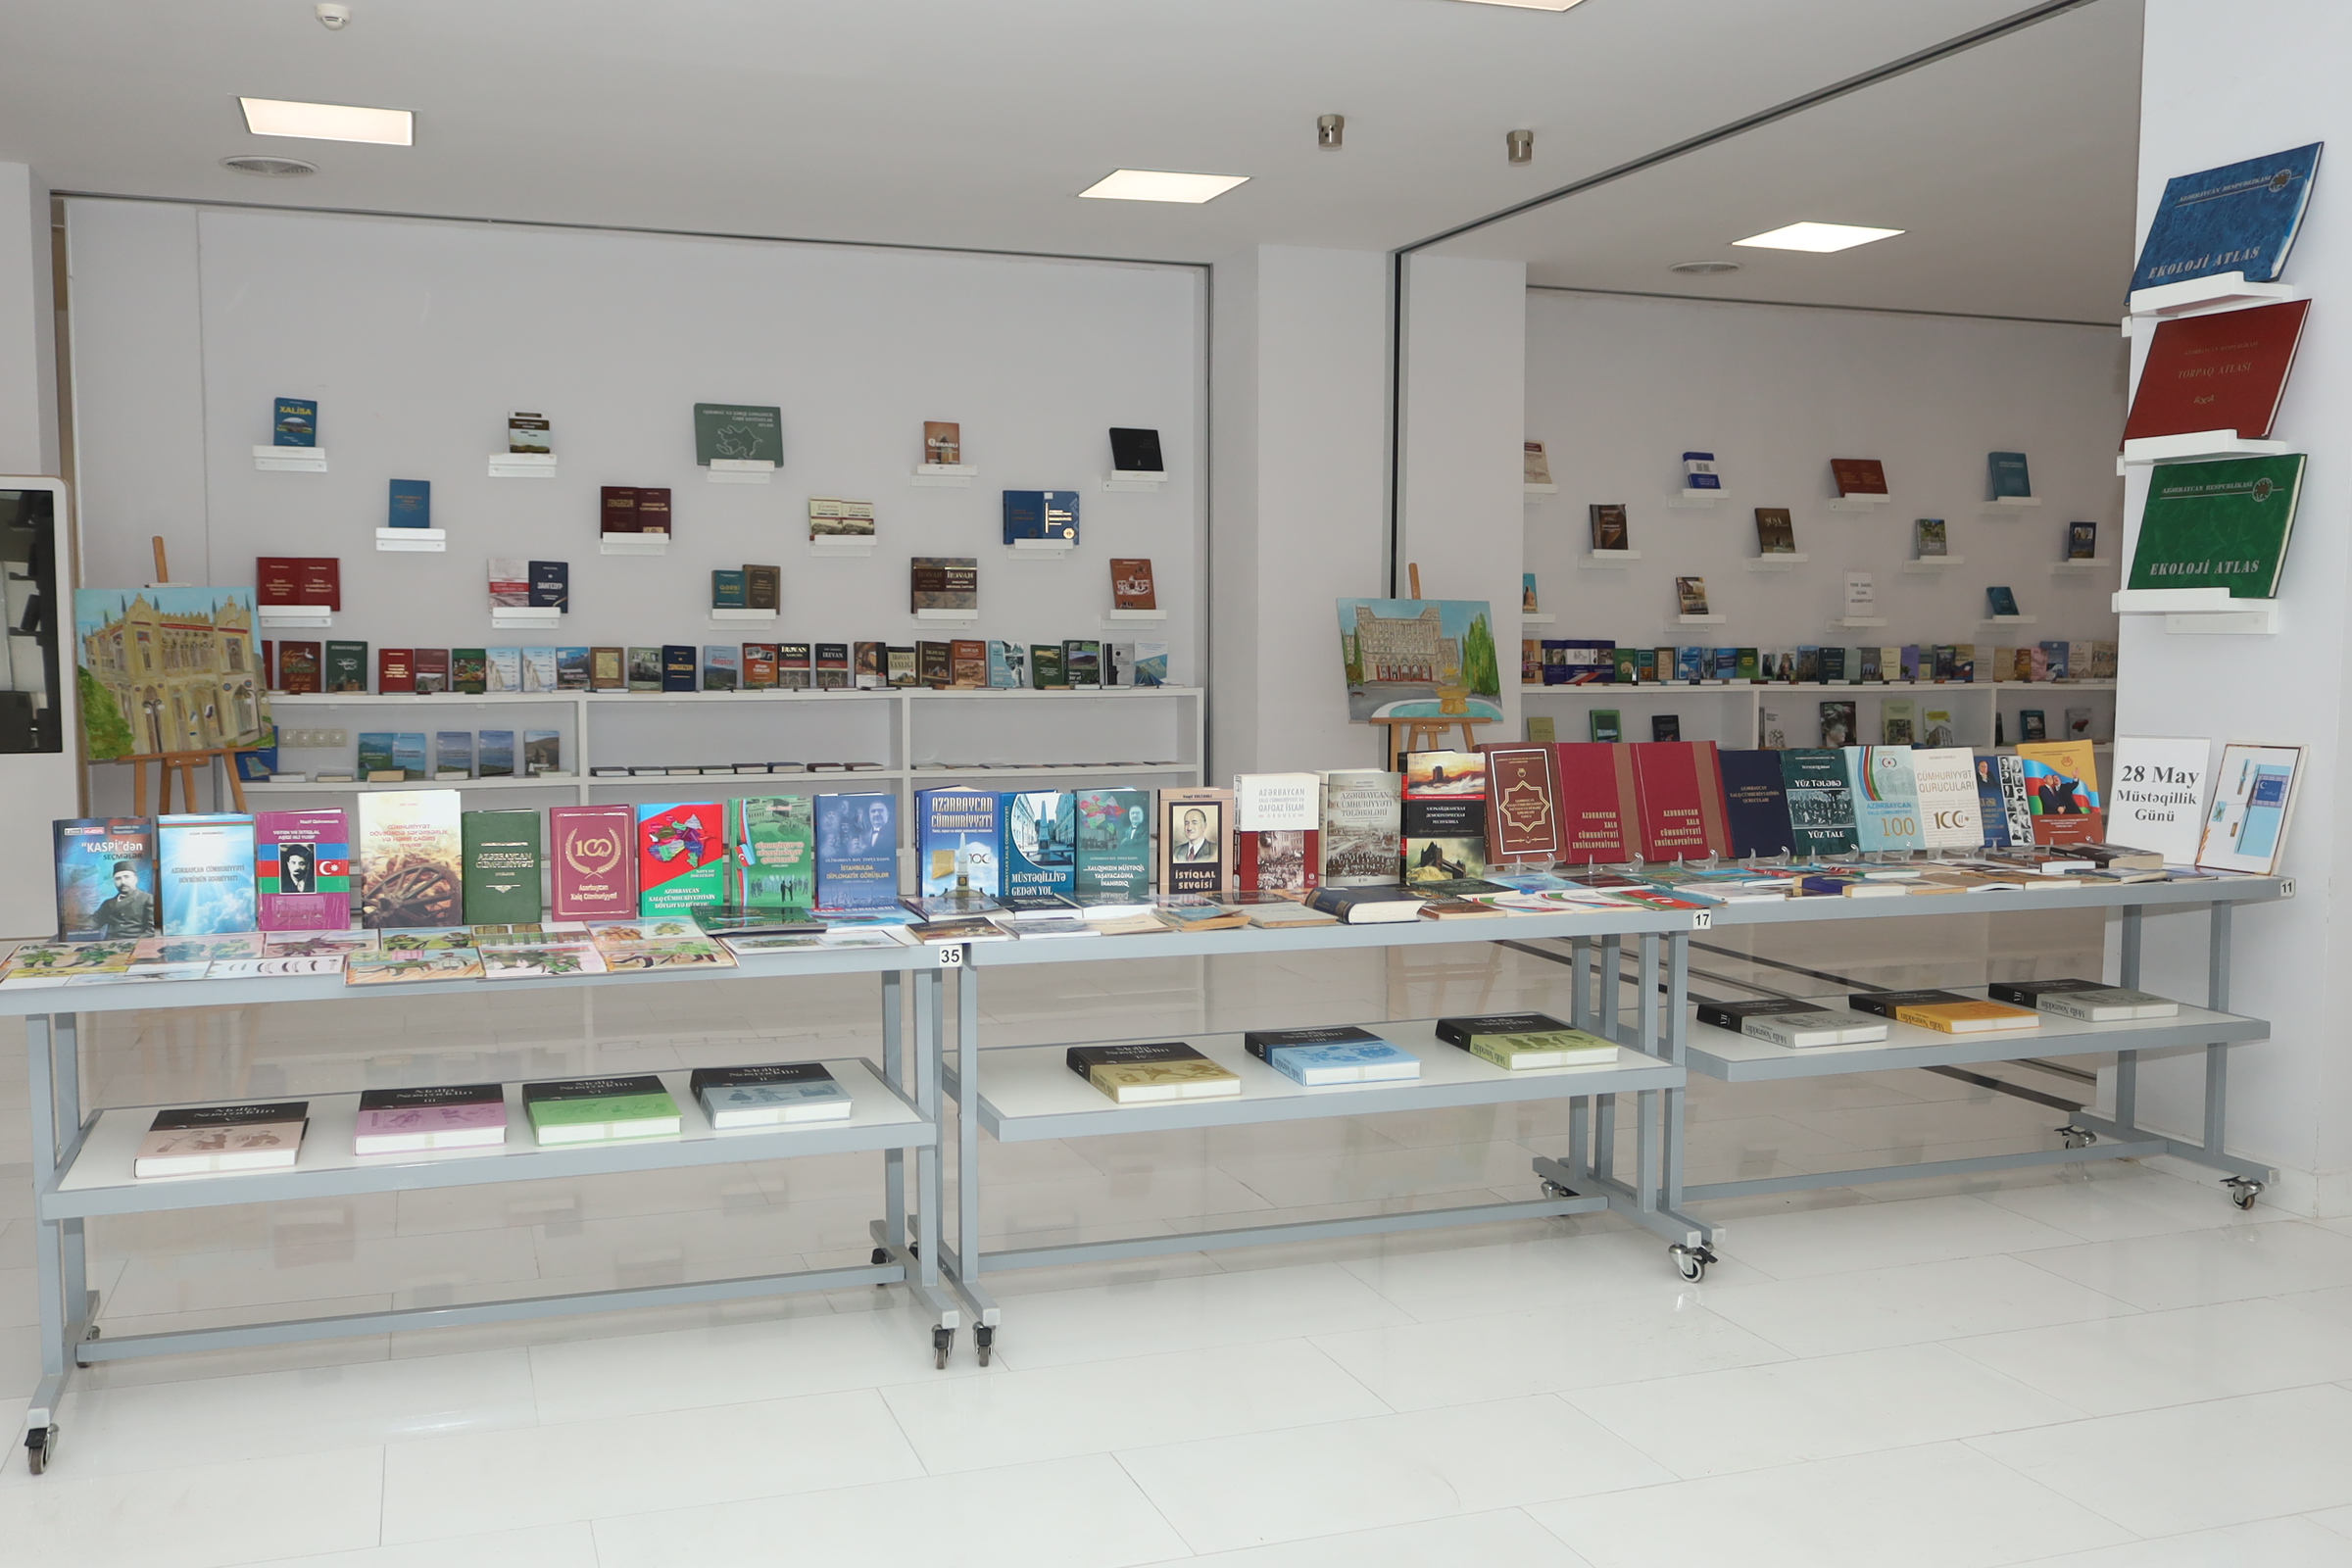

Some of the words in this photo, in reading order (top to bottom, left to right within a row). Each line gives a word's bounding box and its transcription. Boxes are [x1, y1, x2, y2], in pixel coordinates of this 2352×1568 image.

[2147, 254, 2209, 279] EKOLOJİ
[2213, 246, 2261, 267] ATLAS
[2179, 367, 2214, 379] TORPAQ
[2218, 362, 2252, 374] ATLASI
[2150, 559, 2210, 575] EKOLOJİ
[2214, 560, 2260, 574] ATLAS
[1917, 769, 1972, 782] CÜMHURİYYƏT
[2121, 765, 2146, 783] 28
[2151, 766, 2200, 789] May
[1258, 788, 1305, 797] AZƏRBAYCAN
[1919, 783, 1975, 794] QURUCULARI
[932, 797, 993, 812] AZƏRBAYCAN
[2116, 789, 2198, 807] Müstəqillik
[1258, 804, 1284, 812] QAFQAZ
[1285, 802, 1305, 811] İSLAM
[931, 813, 993, 828] CÜMHURİYYƏTİ
[2134, 808, 2176, 822] Günü
[1882, 817, 1916, 837] 100
[1011, 870, 1066, 884] MÜSTƏQİLLİYƏ
[1175, 869, 1216, 880] İSTİQLAL
[1011, 886, 1038, 897] GEDƏN
[1039, 886, 1054, 896] YOL
[1178, 880, 1213, 890] SEVGİSİ
[2281, 882, 2293, 894] 11
[1694, 913, 1710, 926] 17
[941, 949, 960, 963] 35
